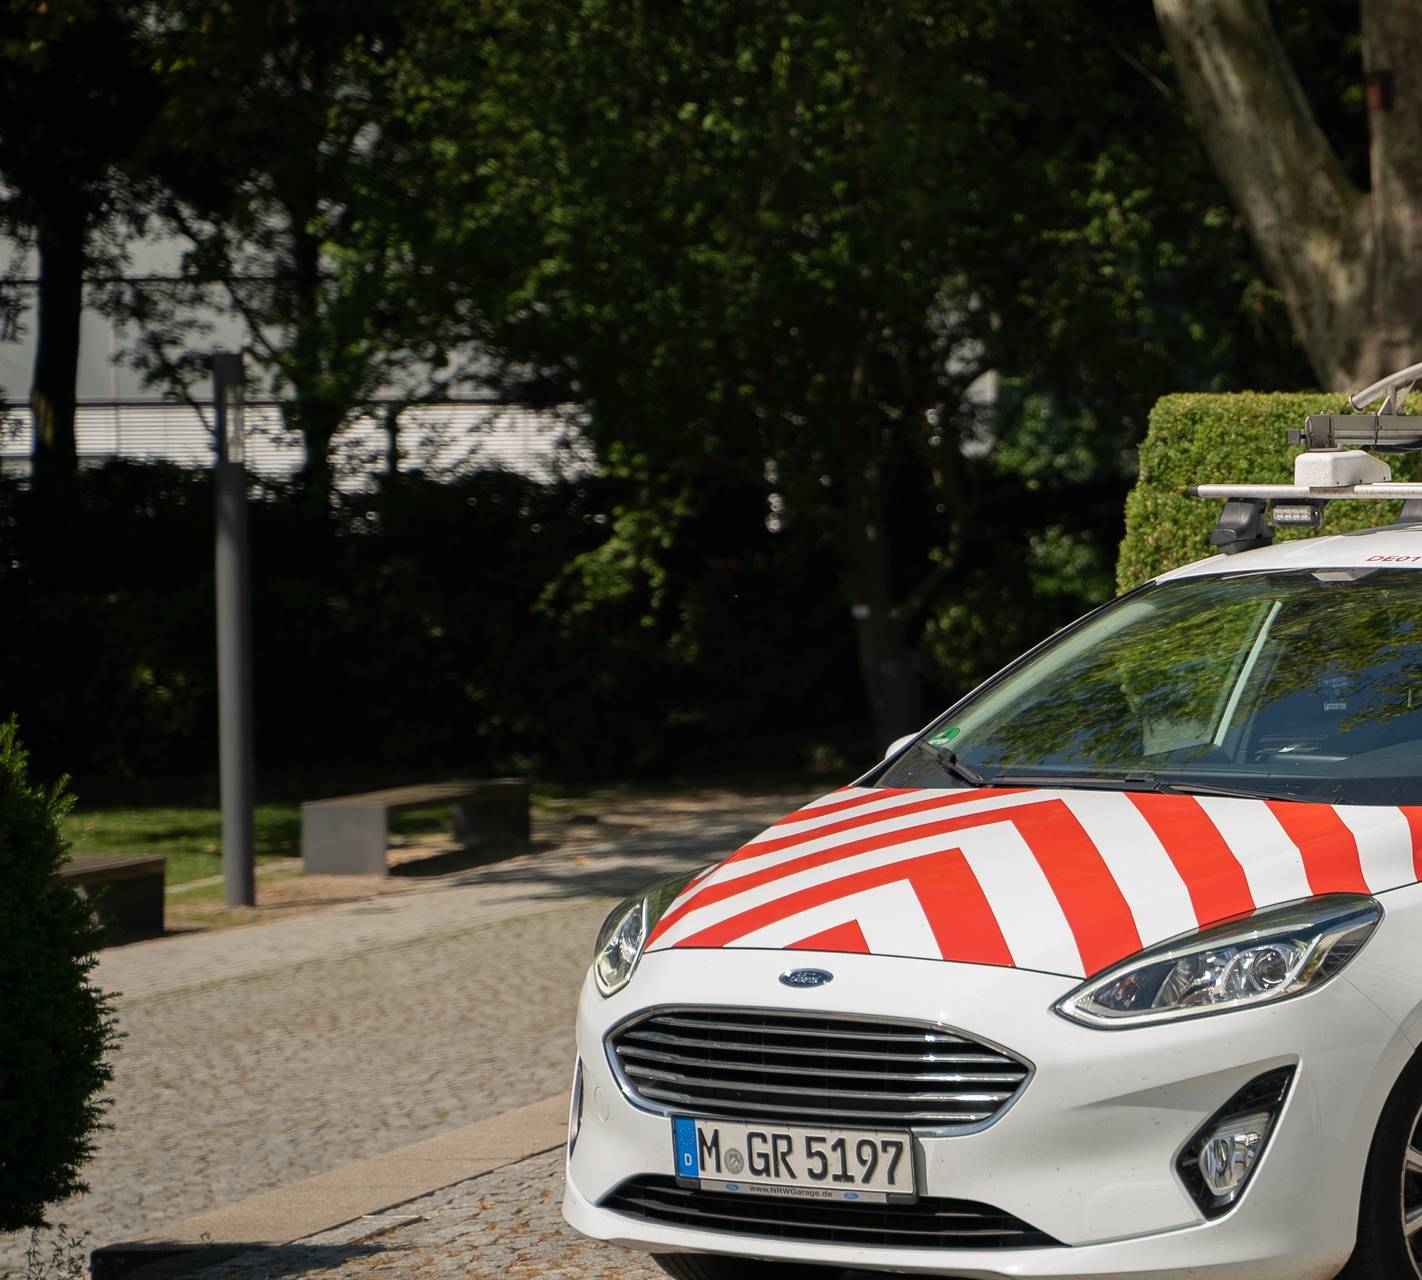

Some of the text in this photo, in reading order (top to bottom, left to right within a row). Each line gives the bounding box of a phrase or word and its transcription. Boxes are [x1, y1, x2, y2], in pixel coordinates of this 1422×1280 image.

[684, 1153, 692, 1166] D
[697, 1127, 904, 1185] M GR 5197
[748, 1185, 833, 1198] www.NRWGarage.de
